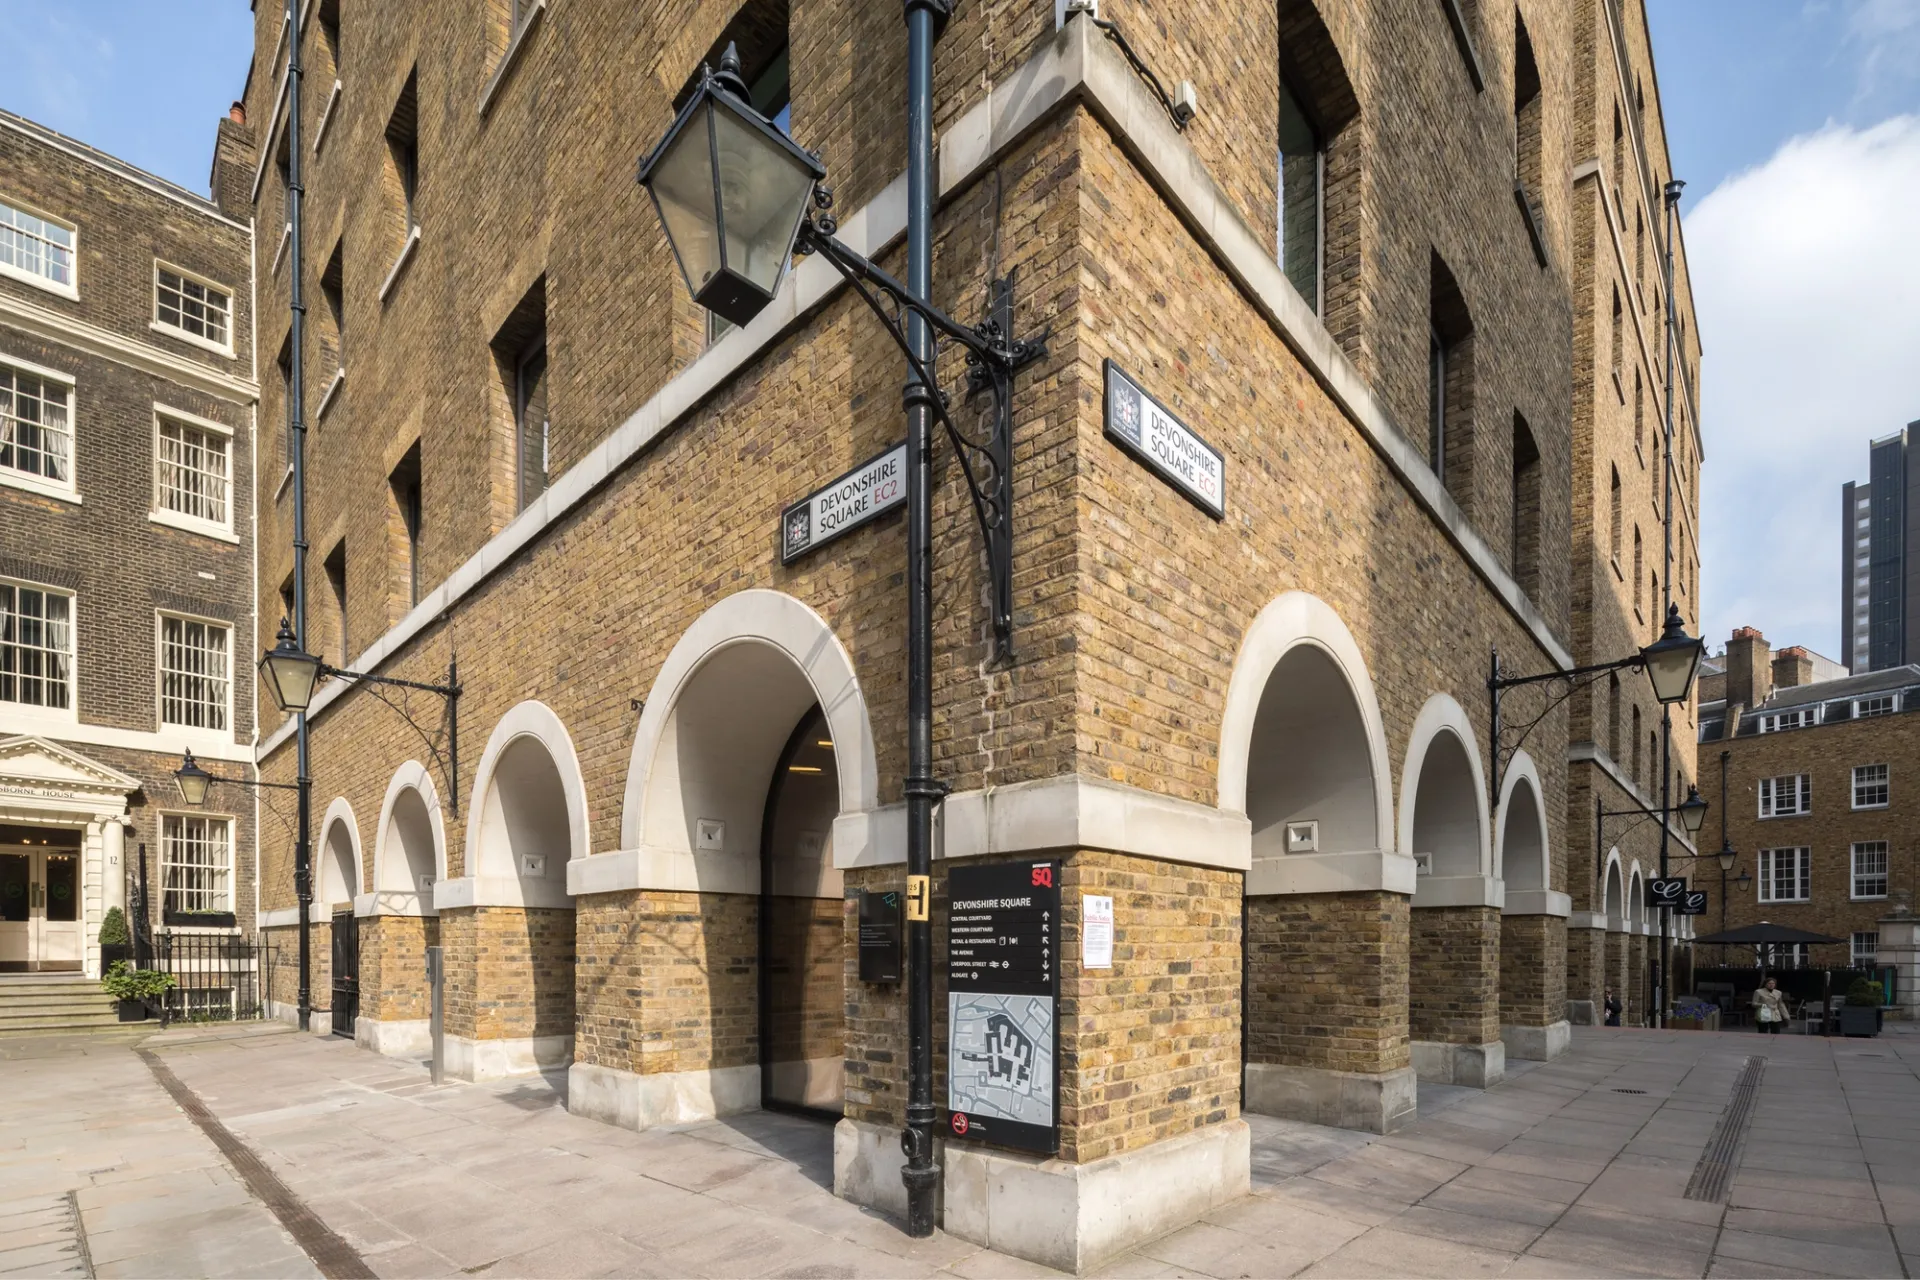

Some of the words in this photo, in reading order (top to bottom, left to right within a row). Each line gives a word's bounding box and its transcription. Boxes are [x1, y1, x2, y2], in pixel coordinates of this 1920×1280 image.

[1151, 411, 1216, 478] DEVONSHIRE
[1151, 436, 1195, 483] SQUARE
[1199, 472, 1216, 499] EC2
[820, 458, 897, 515] DEVONSHIRE
[820, 494, 869, 533] SQUARE
[874, 480, 898, 505] EC2
[42, 790, 76, 798] HOUSE
[110, 856, 118, 865] 12
[1032, 868, 1052, 888] SQ
[953, 899, 999, 910] DEVONSHIRE
[1000, 897, 1032, 908] SQUARE
